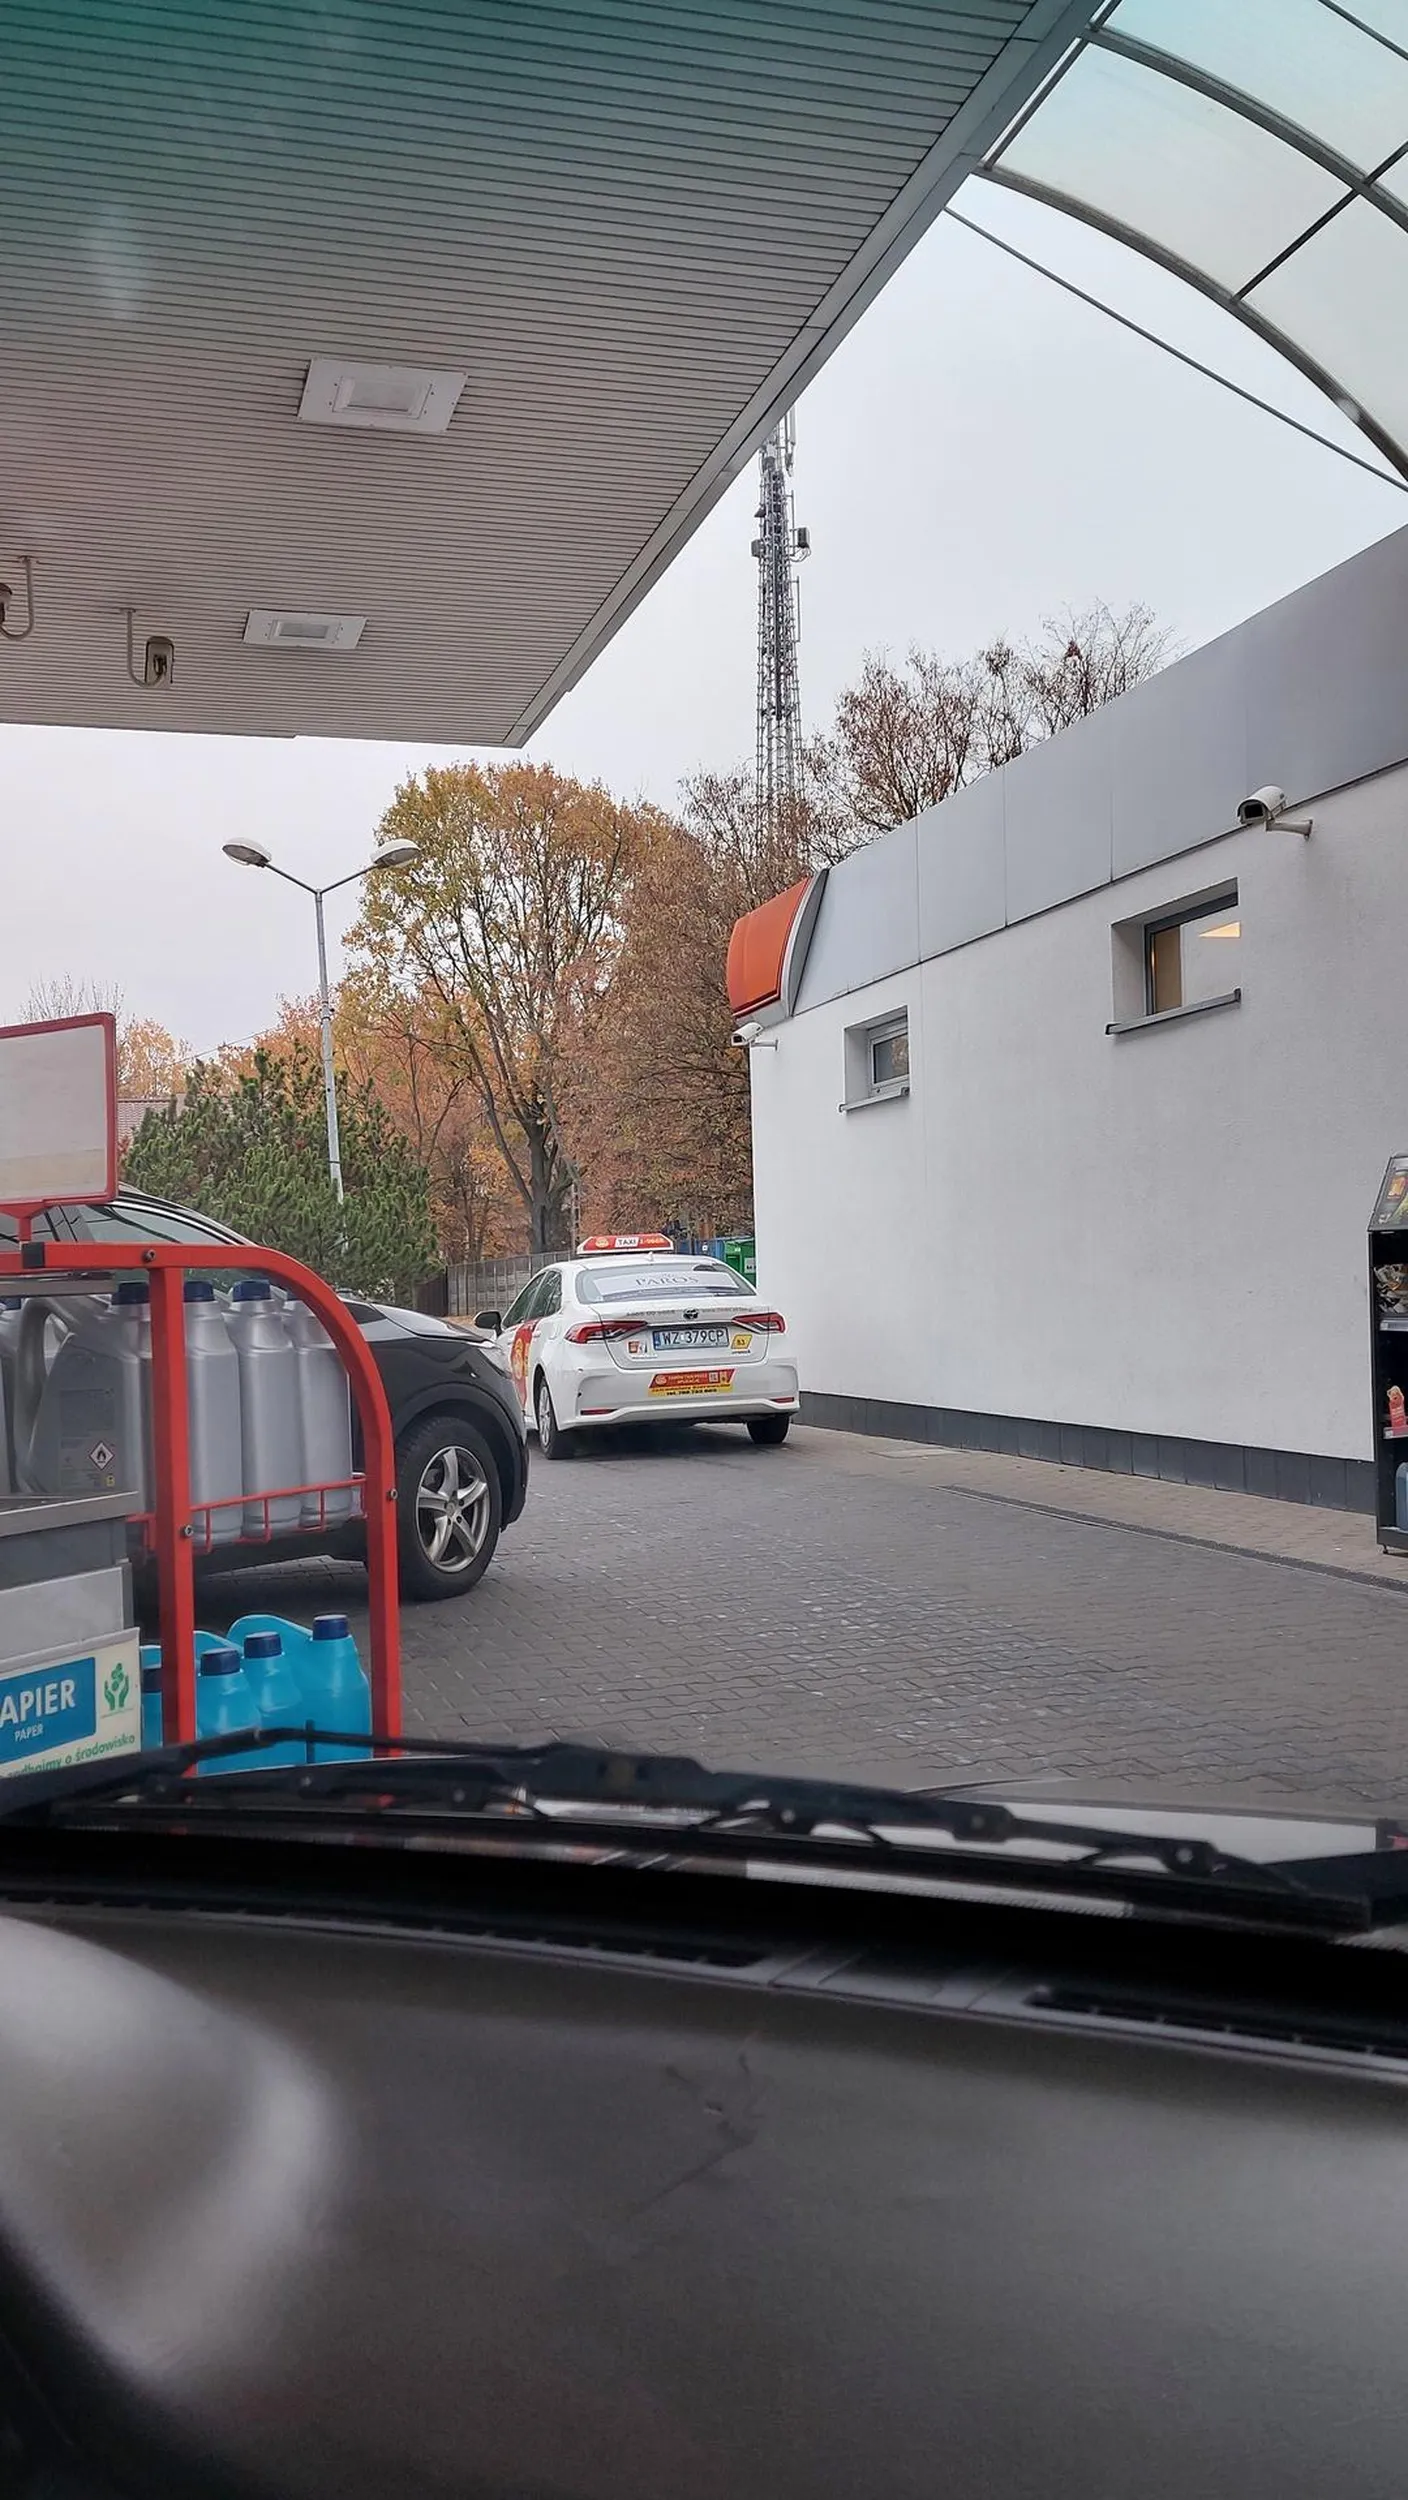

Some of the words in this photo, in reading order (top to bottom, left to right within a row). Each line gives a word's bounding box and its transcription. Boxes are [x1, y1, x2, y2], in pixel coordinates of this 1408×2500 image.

[636, 1276, 699, 1285] PAROS
[662, 1331, 680, 1345] WZ
[684, 1330, 724, 1344] 379CP
[14, 1723, 44, 1742] PAPER
[64, 1754, 72, 1764] o
[76, 1733, 136, 1761] środowisko
